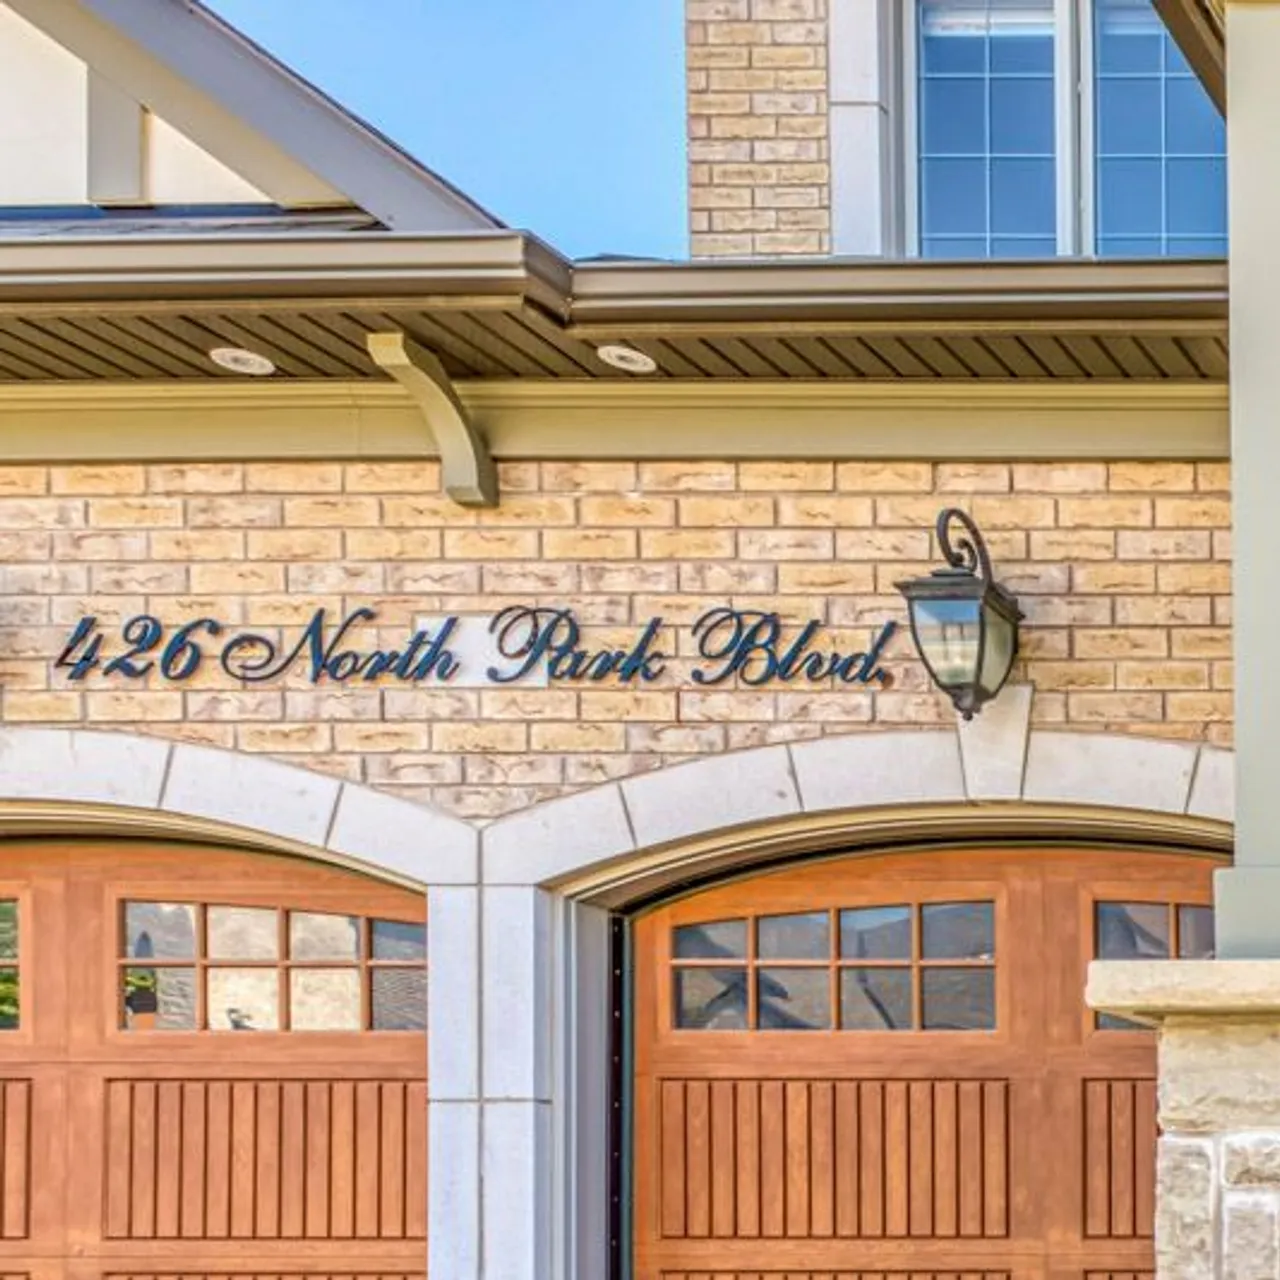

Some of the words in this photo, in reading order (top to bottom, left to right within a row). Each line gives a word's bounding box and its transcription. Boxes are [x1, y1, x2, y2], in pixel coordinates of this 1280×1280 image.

[55, 614, 223, 682] 426
[220, 607, 462, 684] North
[487, 605, 668, 684] Park
